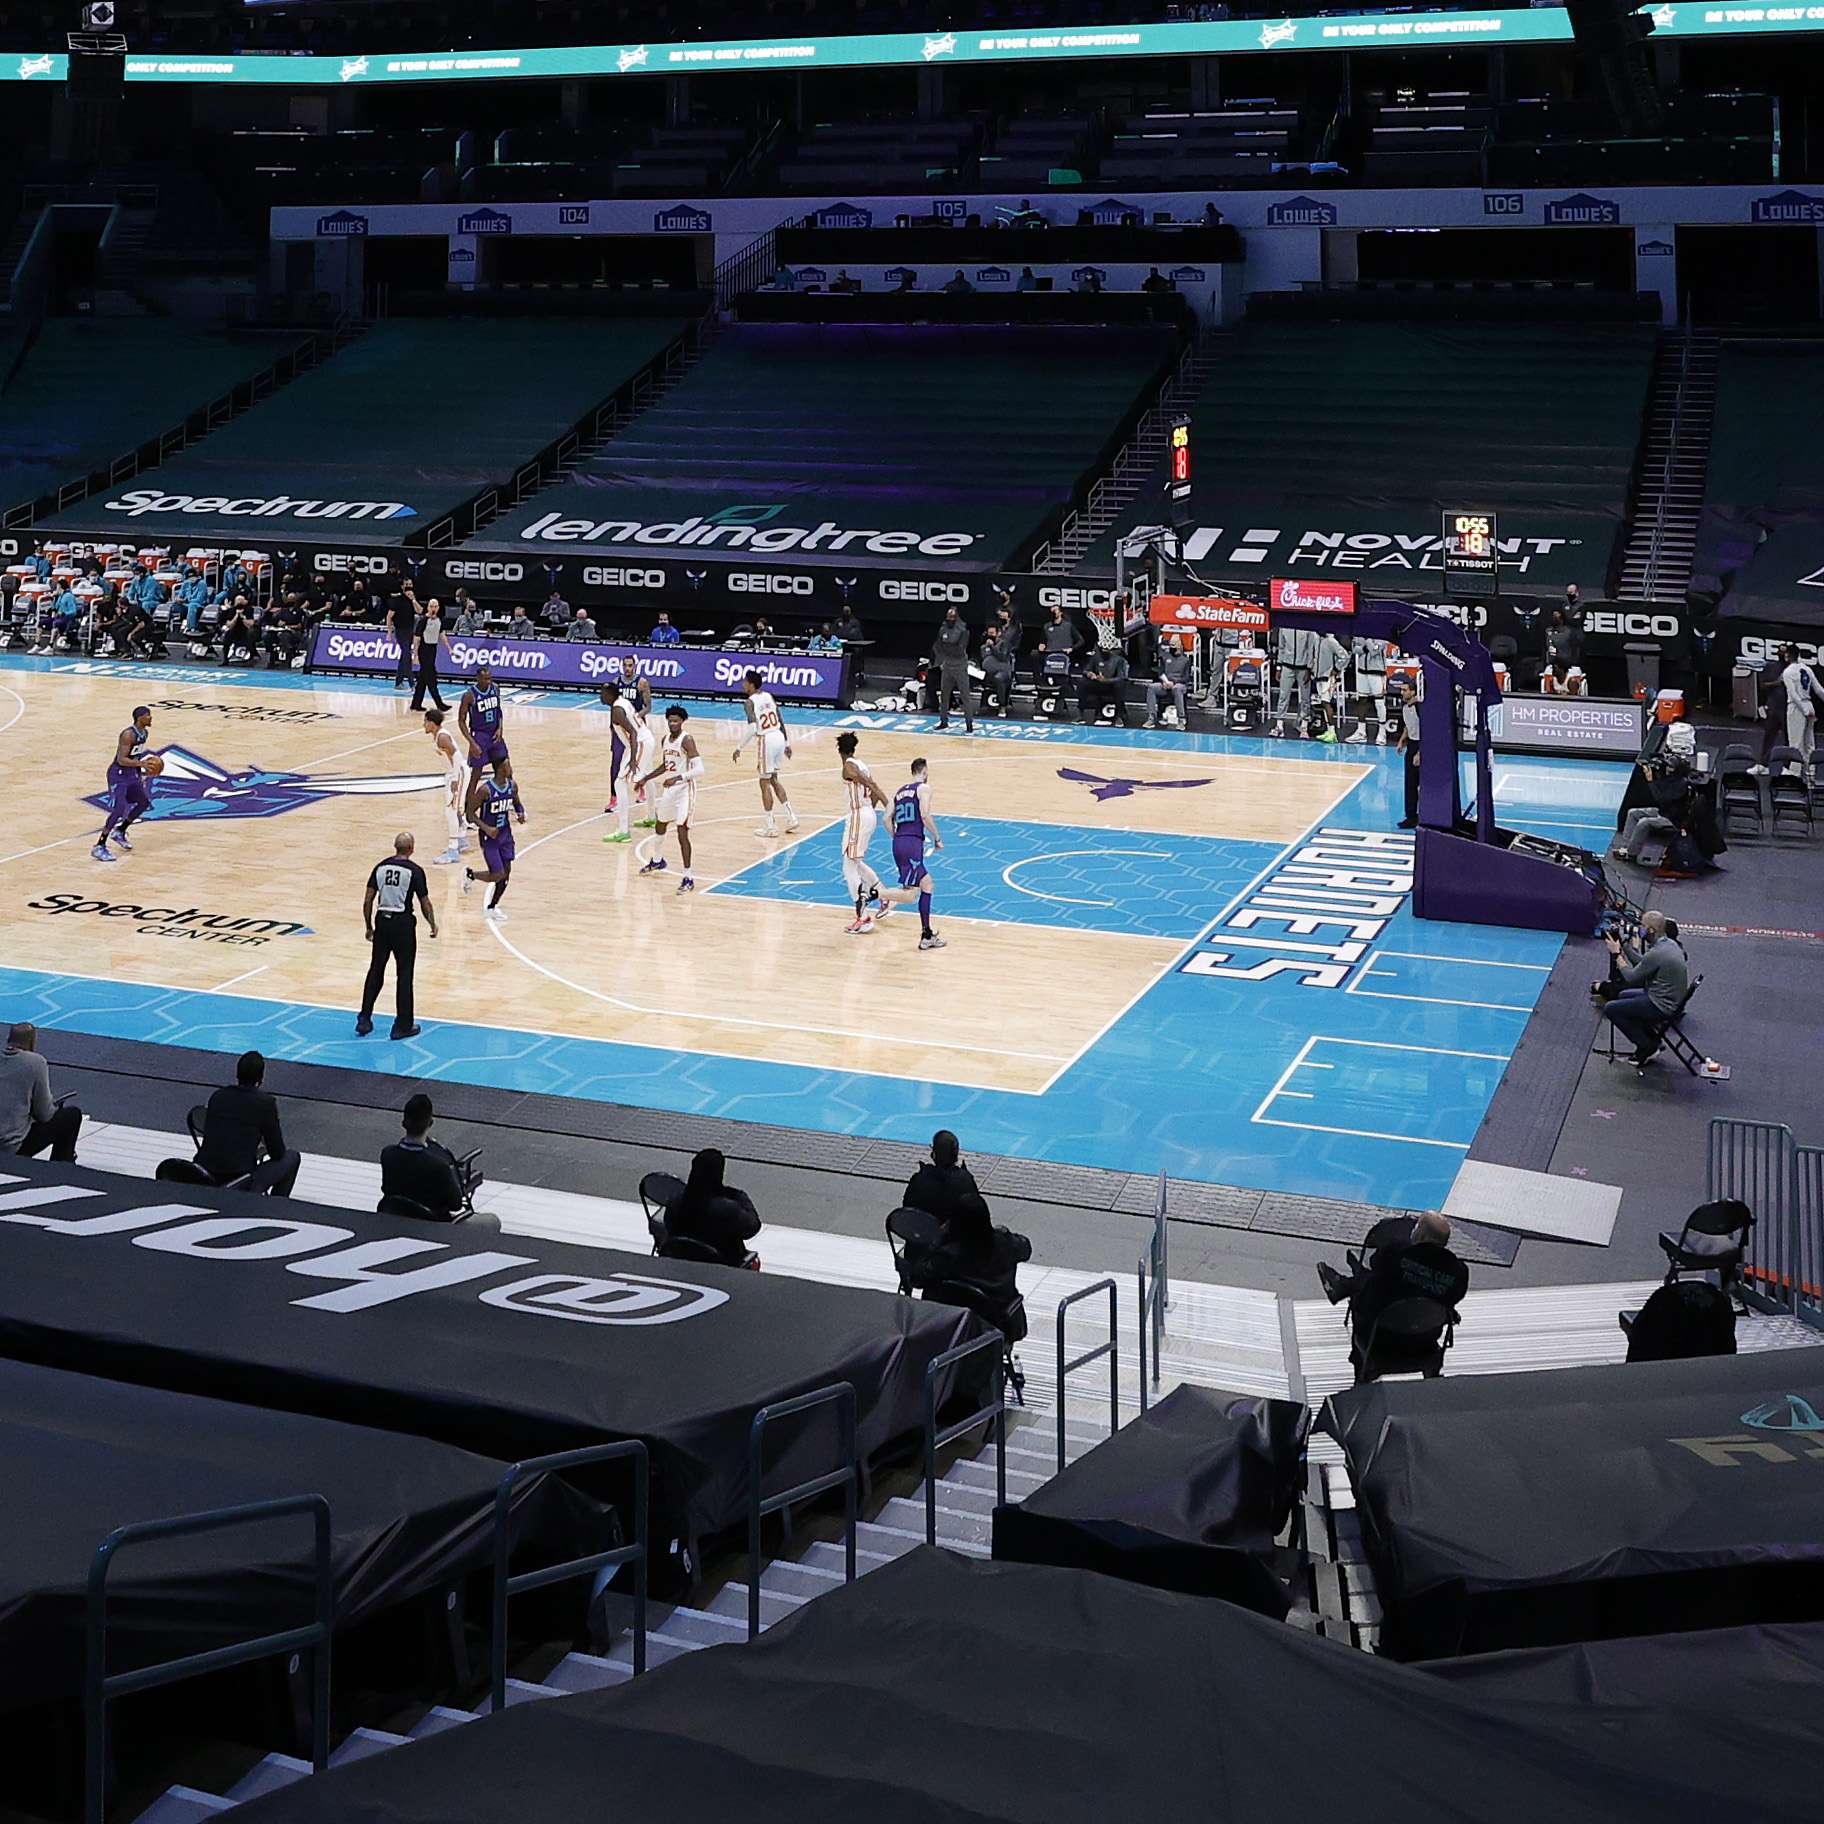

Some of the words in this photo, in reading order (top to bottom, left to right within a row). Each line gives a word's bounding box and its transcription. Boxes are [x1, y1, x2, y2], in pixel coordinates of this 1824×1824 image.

[936, 203, 964, 217] 105
[1487, 196, 1521, 213] 106
[1551, 204, 1614, 223] LOWE'S
[1758, 202, 1824, 222] LOWE'S
[463, 217, 507, 233] LOWE'S
[561, 209, 587, 222] 104
[659, 215, 708, 230] LOWE'S
[817, 212, 867, 228] LOWE'S
[1273, 208, 1331, 225] LOWE'S
[320, 220, 365, 234] LOWE'S
[105, 489, 396, 520] Spectrum
[520, 512, 974, 555] lendingtree
[1464, 534, 1483, 554] 18
[445, 561, 523, 581] GEICO
[583, 567, 665, 588] GEICO
[728, 573, 814, 595] GEICO
[879, 580, 969, 603] GEICO
[450, 641, 546, 671] Spectrum
[1430, 639, 1466, 671] SPALDING
[148, 699, 332, 721] Spectrum
[477, 696, 497, 712] CHA
[760, 711, 777, 730] 20
[1512, 707, 1537, 722] HM
[1540, 708, 1633, 727] PROPERTIES
[1538, 729, 1564, 739] REAL
[1566, 731, 1604, 740] ESTATE
[896, 802, 915, 822] 20
[385, 869, 400, 887] 23
[27, 891, 303, 936] Spectrum
[1179, 827, 1415, 988] HORNETS
[136, 924, 269, 950] CENTER
